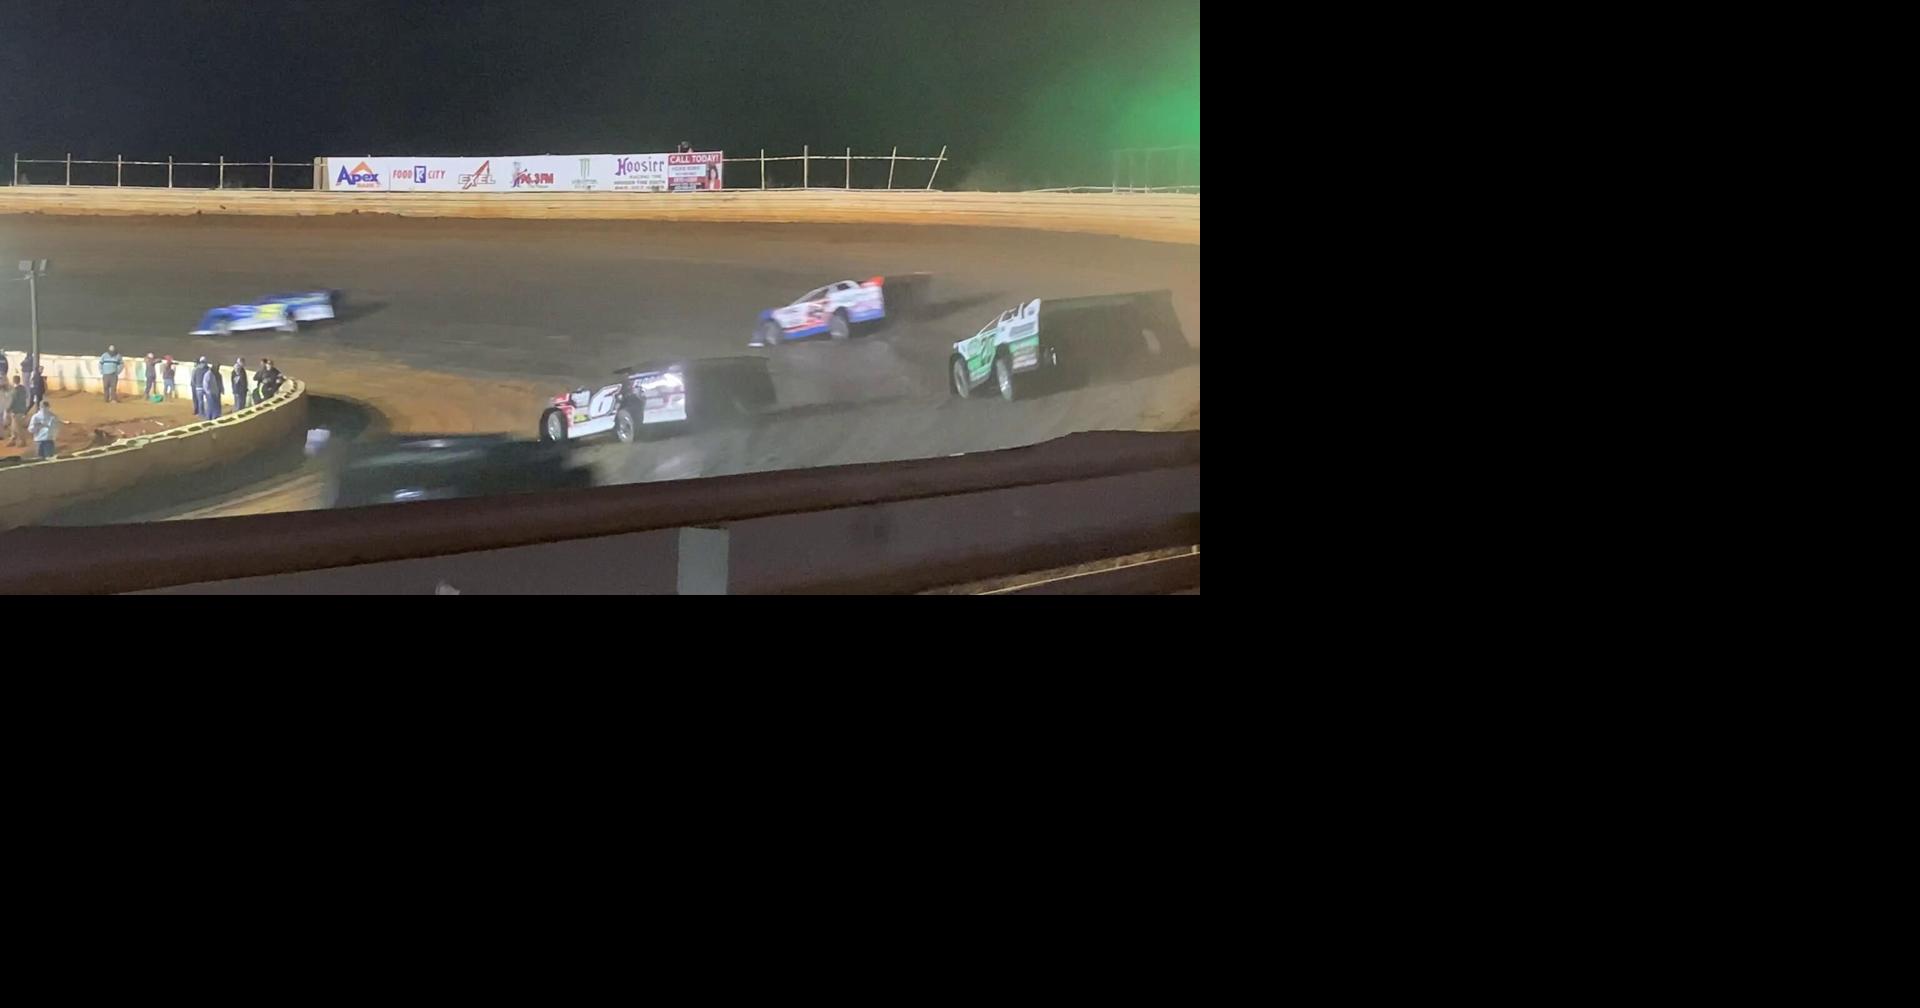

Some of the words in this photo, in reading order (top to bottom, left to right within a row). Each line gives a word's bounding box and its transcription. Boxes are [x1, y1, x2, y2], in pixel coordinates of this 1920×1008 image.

[615, 156, 665, 176] Hoosier
[669, 154, 690, 164] CALL
[692, 153, 719, 163] TODAY!
[337, 164, 379, 185] Apex
[393, 170, 412, 179] FOOD
[428, 169, 446, 180] CITY
[589, 383, 623, 419] 6
